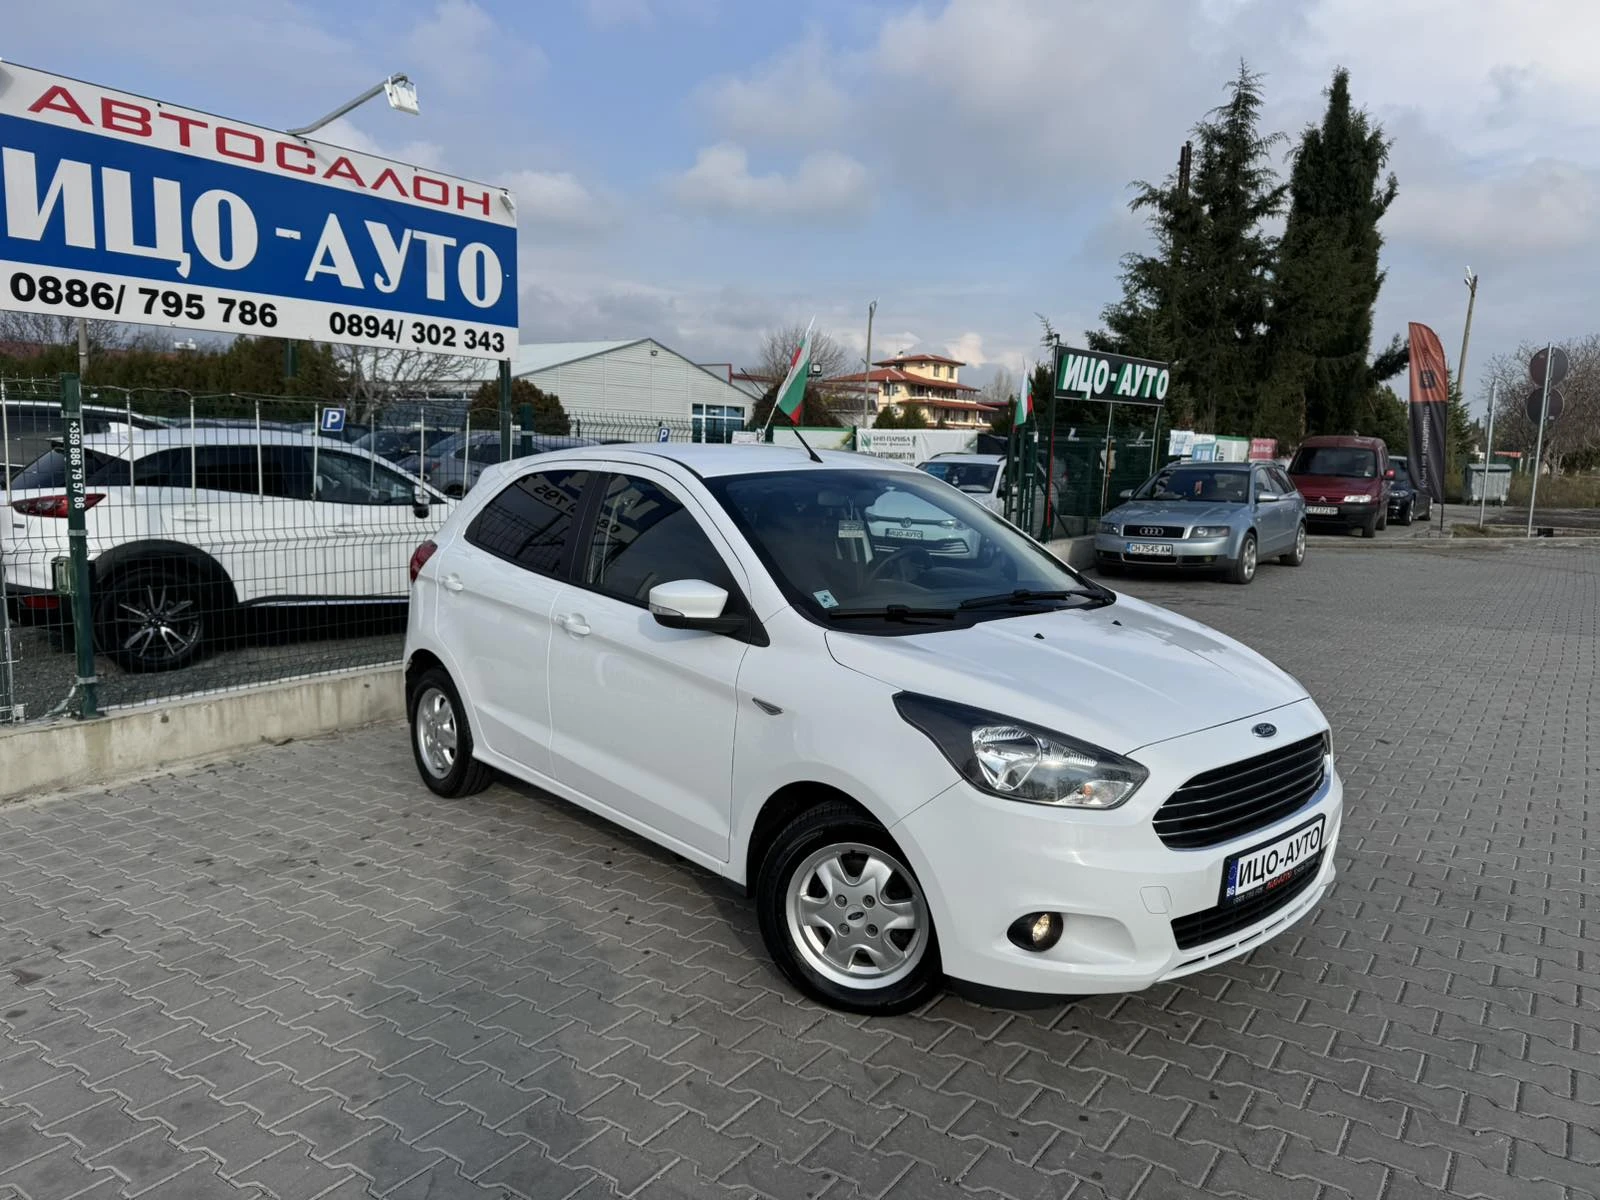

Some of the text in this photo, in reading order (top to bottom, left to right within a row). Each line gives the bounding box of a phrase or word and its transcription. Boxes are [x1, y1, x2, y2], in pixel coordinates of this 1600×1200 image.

[27, 85, 490, 216] АВТОСАЛОН
[10, 272, 278, 328] 0886/ 795 786
[329, 312, 505, 353] 0894/ 302 343
[1059, 354, 1170, 400] ИЦО-АУТО
[326, 411, 340, 428] P
[660, 428, 668, 441] P
[69, 421, 85, 509] +359 886 79 57 86
[1238, 826, 1321, 888] ИЦО-АУТО
[1226, 886, 1235, 897] BG
